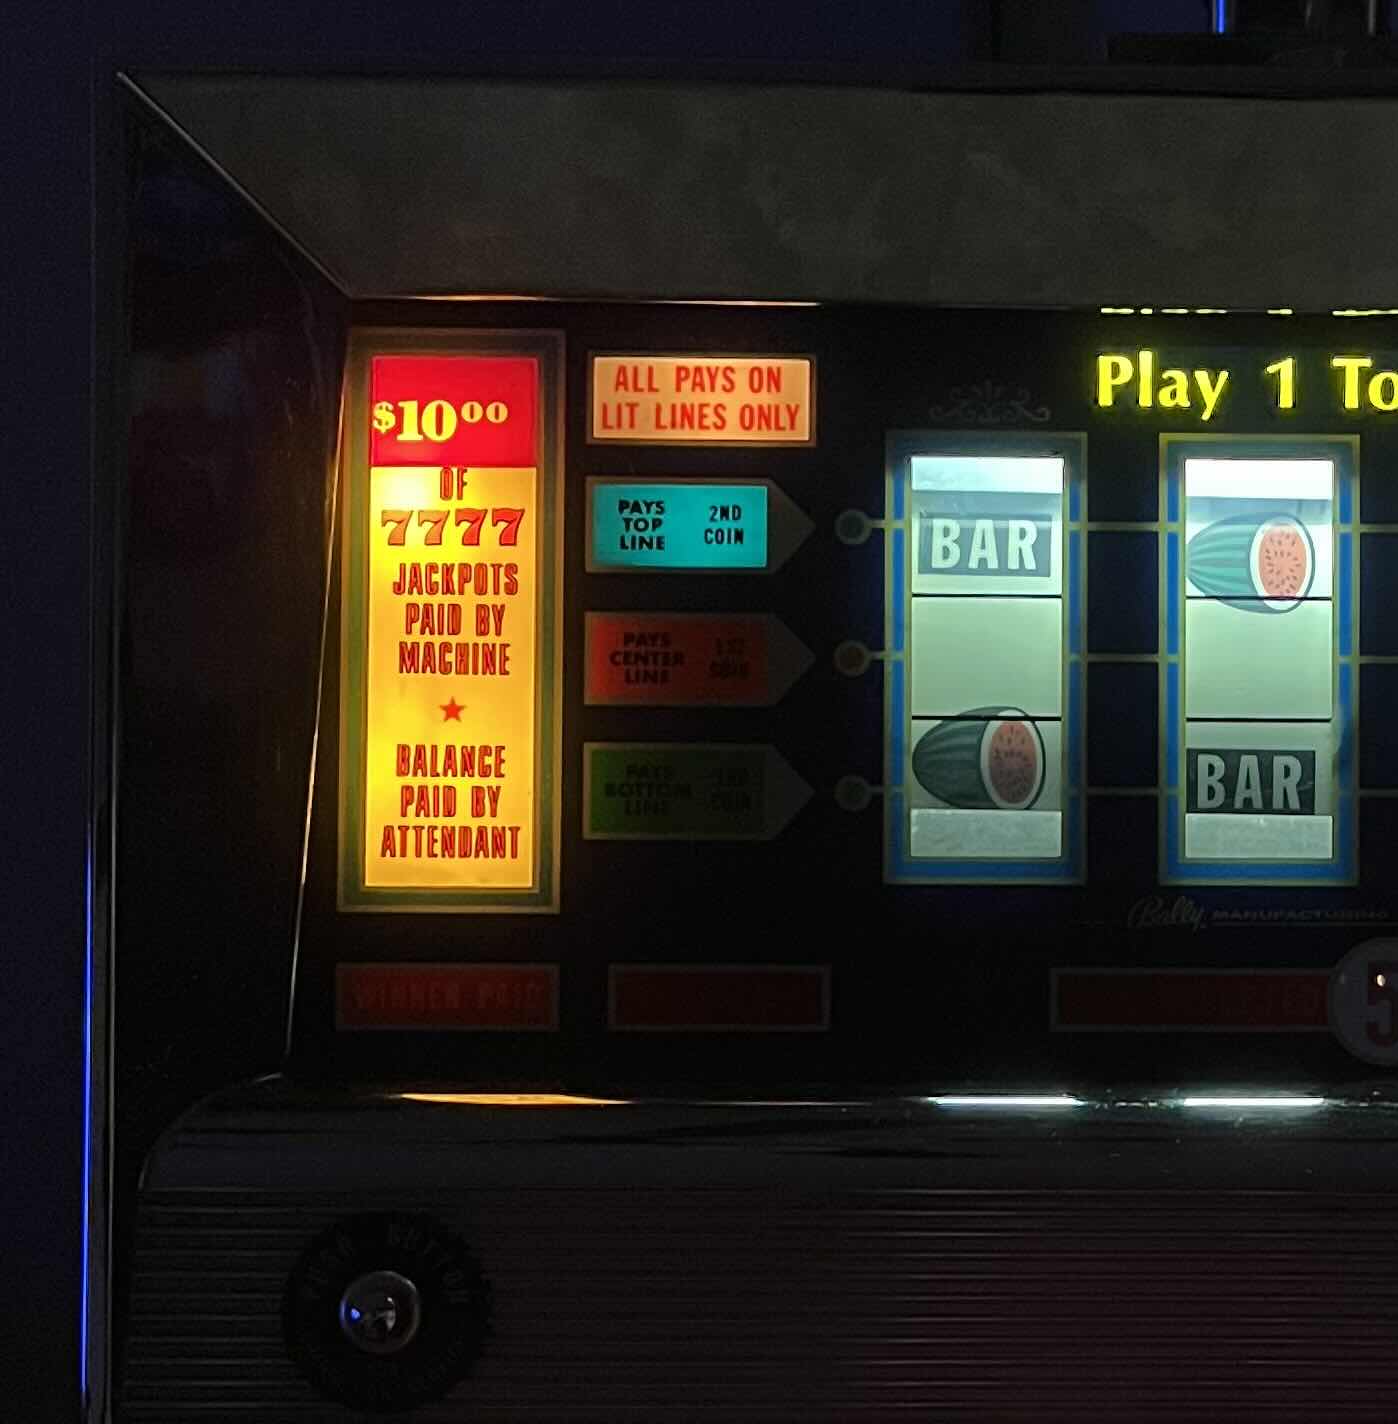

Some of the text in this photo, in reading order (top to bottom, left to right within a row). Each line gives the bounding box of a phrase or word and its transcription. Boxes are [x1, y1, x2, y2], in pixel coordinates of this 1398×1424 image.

[615, 365, 782, 393] ALL PAYS ON
[1097, 350, 1228, 420] Play
[1266, 358, 1295, 408] 1
[601, 403, 800, 432] LIT LINES ONLY
[440, 467, 468, 501] OF
[618, 499, 743, 522] PAYS 2ND
[619, 534, 666, 552] LINE
[623, 517, 745, 546] TOP COIN
[930, 517, 1040, 572] BAR
[392, 562, 519, 596] JACKPOTS
[405, 603, 506, 637] PAID BY
[624, 632, 671, 647] PAYS
[399, 641, 511, 676] MACHINE
[610, 651, 686, 666] CENTER
[625, 669, 670, 684] LINE
[396, 743, 506, 778] BALANCE
[1195, 752, 1303, 811] BAR
[400, 784, 502, 819] PAID BY
[380, 824, 521, 859] ATTENDANT
